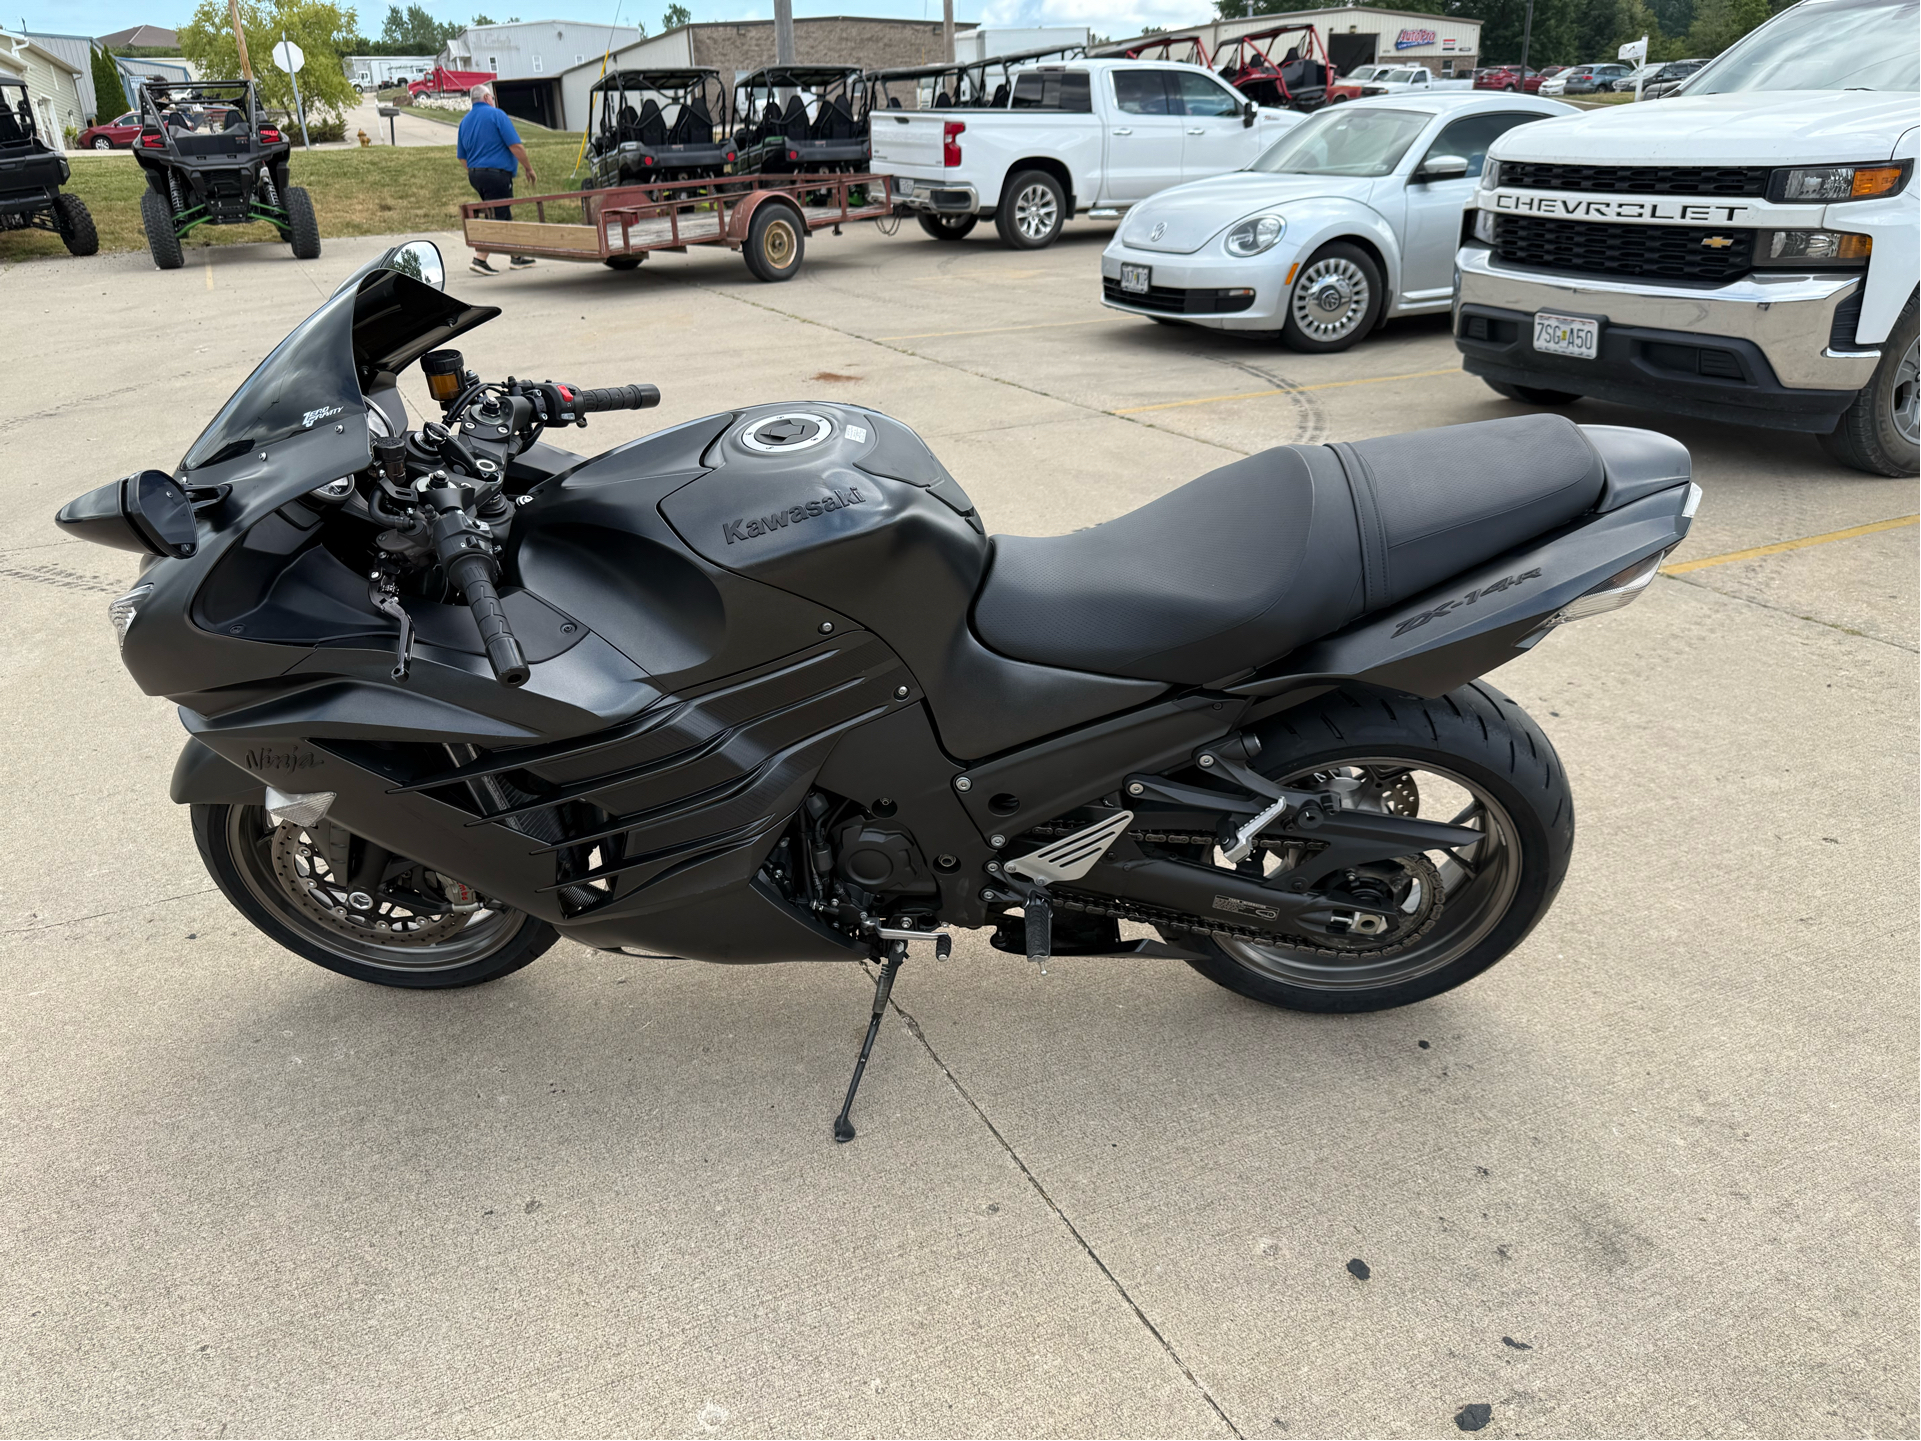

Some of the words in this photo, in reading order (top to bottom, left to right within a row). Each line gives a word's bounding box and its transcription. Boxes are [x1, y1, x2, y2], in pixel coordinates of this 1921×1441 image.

[1496, 195, 1748, 222] CHEVROLET
[302, 406, 330, 425] ZERO
[723, 486, 866, 545] Kawasaki
[1390, 567, 1542, 639] ZX-14R
[245, 745, 325, 776] Ninja
